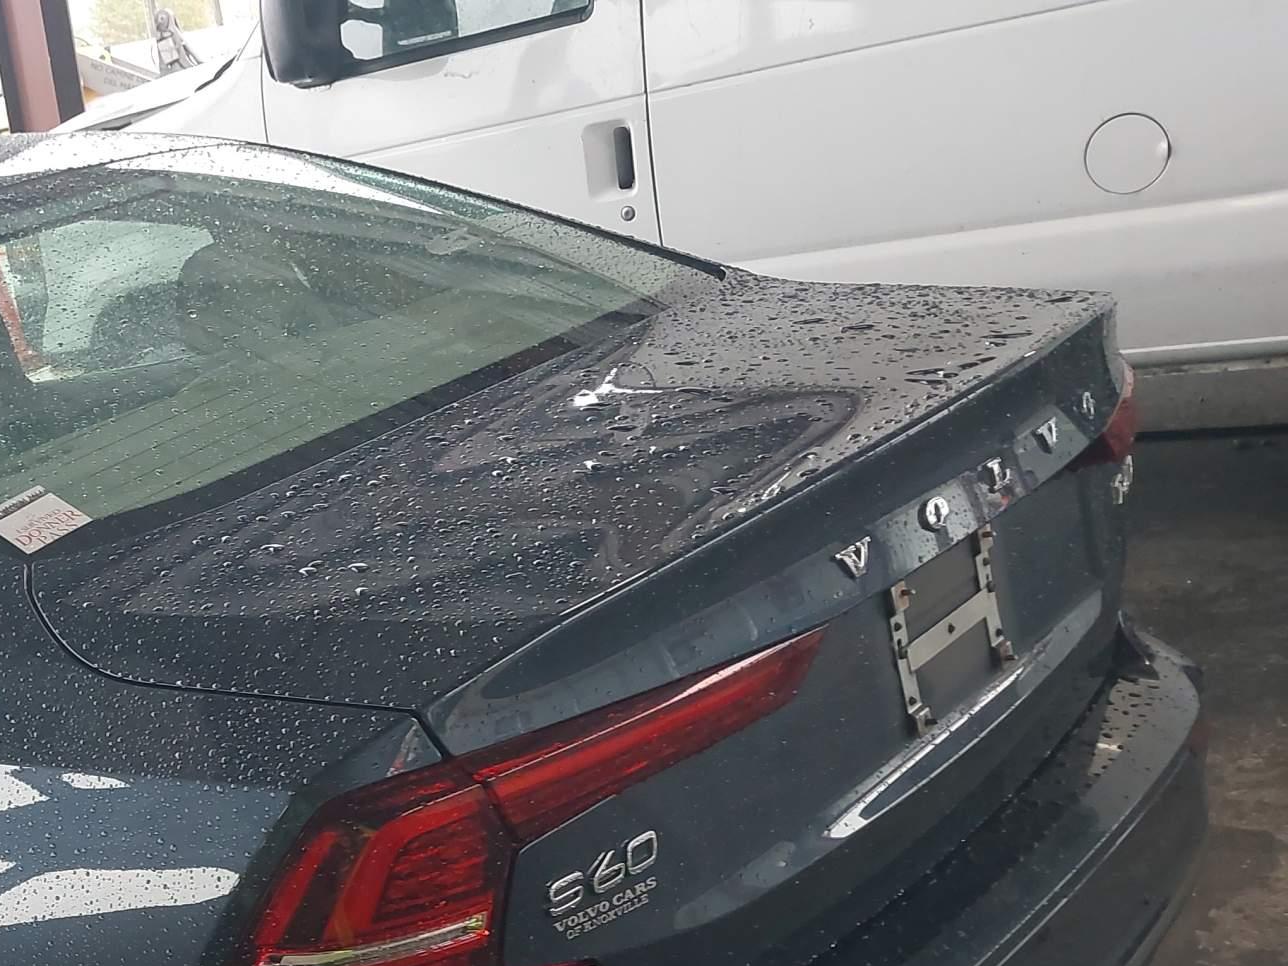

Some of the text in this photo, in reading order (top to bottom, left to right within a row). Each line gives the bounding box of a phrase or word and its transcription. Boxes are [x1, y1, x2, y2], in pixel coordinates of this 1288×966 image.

[834, 391, 1097, 578] VOLVO
[14, 509, 82, 546] DONNER
[37, 522, 78, 545] PASS
[546, 830, 657, 917] S60
[553, 876, 657, 932] VOLVO CARS
[566, 894, 649, 940] OF KNOXVILLE
